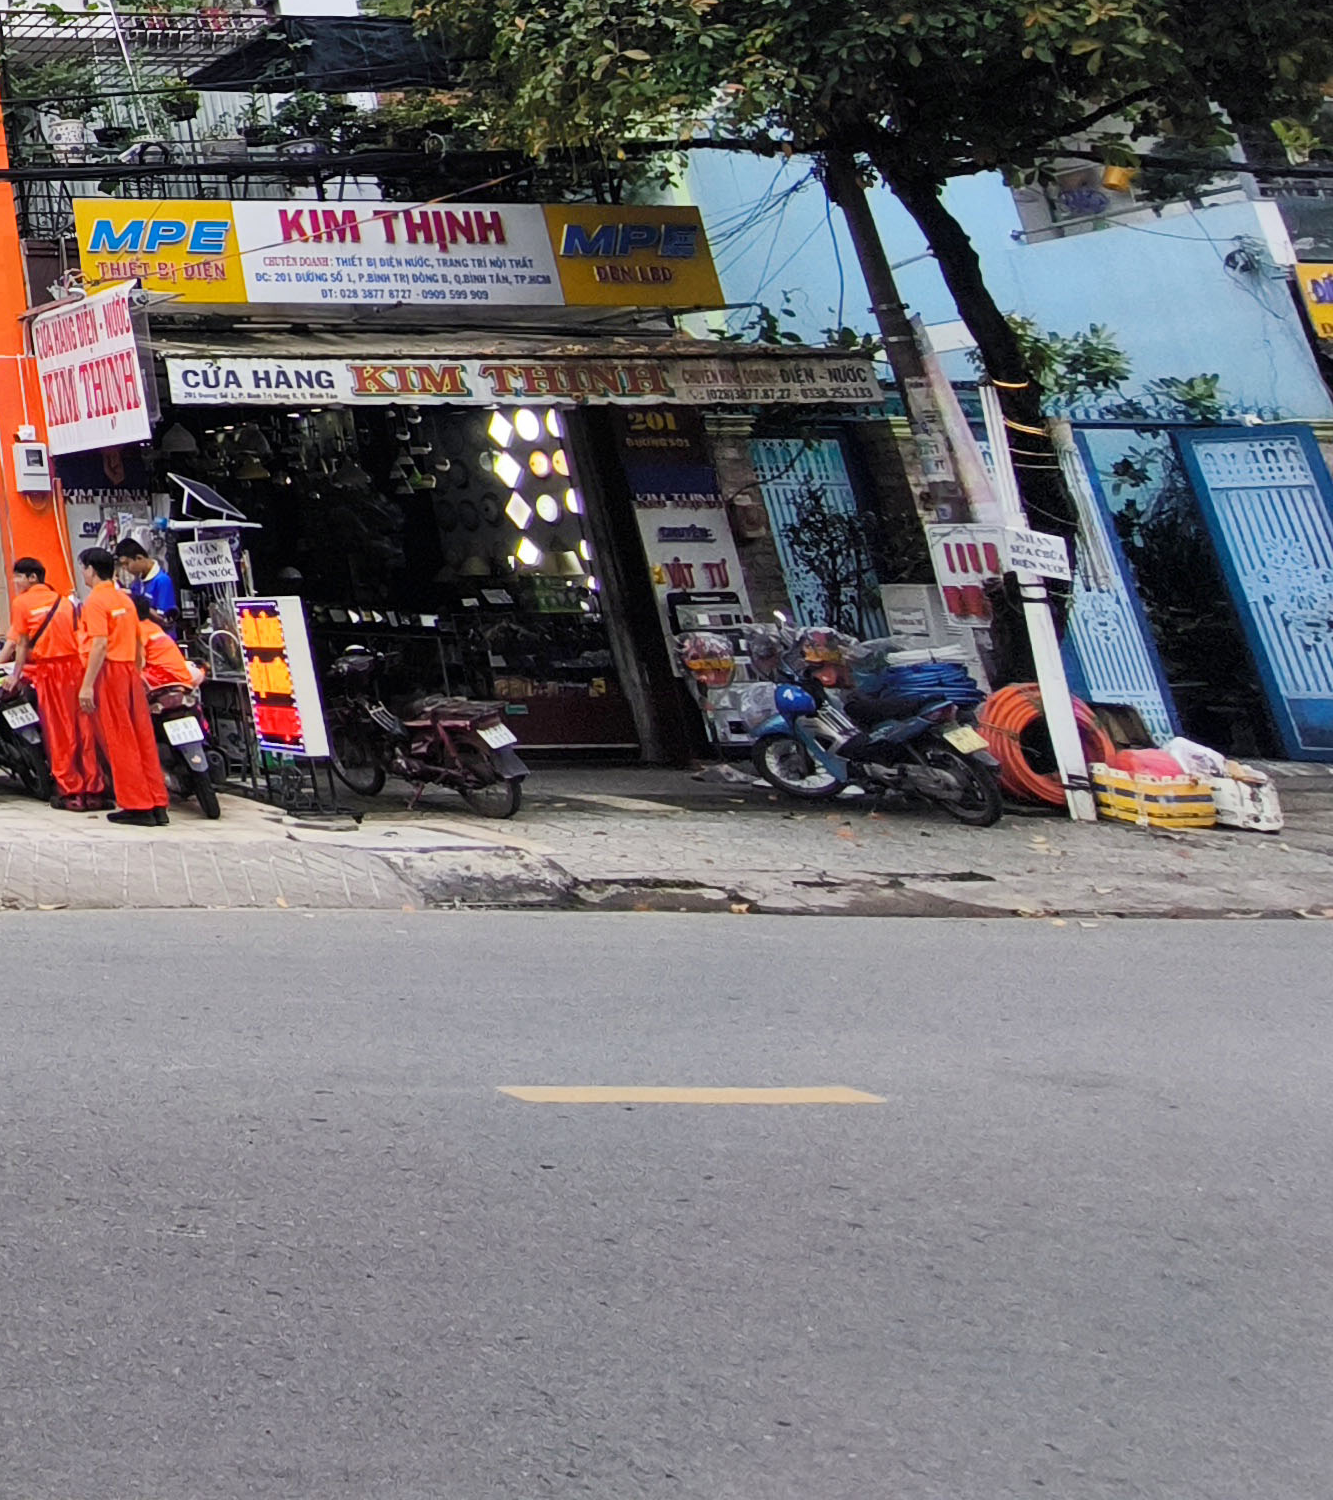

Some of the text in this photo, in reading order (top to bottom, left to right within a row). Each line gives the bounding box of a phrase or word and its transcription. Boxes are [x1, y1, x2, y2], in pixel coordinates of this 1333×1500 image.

[87, 219, 231, 253] MPE
[279, 209, 507, 252] KIM THỊNH
[560, 223, 698, 258] MPE
[97, 256, 152, 279] THIẾT
[275, 273, 292, 282] 201
[295, 270, 328, 282] ĐƯỜNG
[332, 270, 343, 282] SỐ
[393, 274, 410, 285] TRỊ
[335, 254, 363, 267] THIẾT
[367, 257, 377, 269] BỊ
[380, 255, 402, 269] ĐIỆN
[436, 258, 469, 268] TRANG
[471, 257, 487, 268] TRÍ
[340, 289, 359, 299] 028
[362, 289, 384, 299] 3877
[388, 289, 412, 299] 8727
[421, 289, 446, 300] 0909
[449, 289, 468, 300] 599
[470, 290, 489, 300] 909
[51, 314, 78, 356] HÀNG
[43, 348, 141, 430] KIM THỊNH
[182, 362, 676, 400] CỬA HÀNG KIM THỊNH
[627, 410, 678, 431] 201
